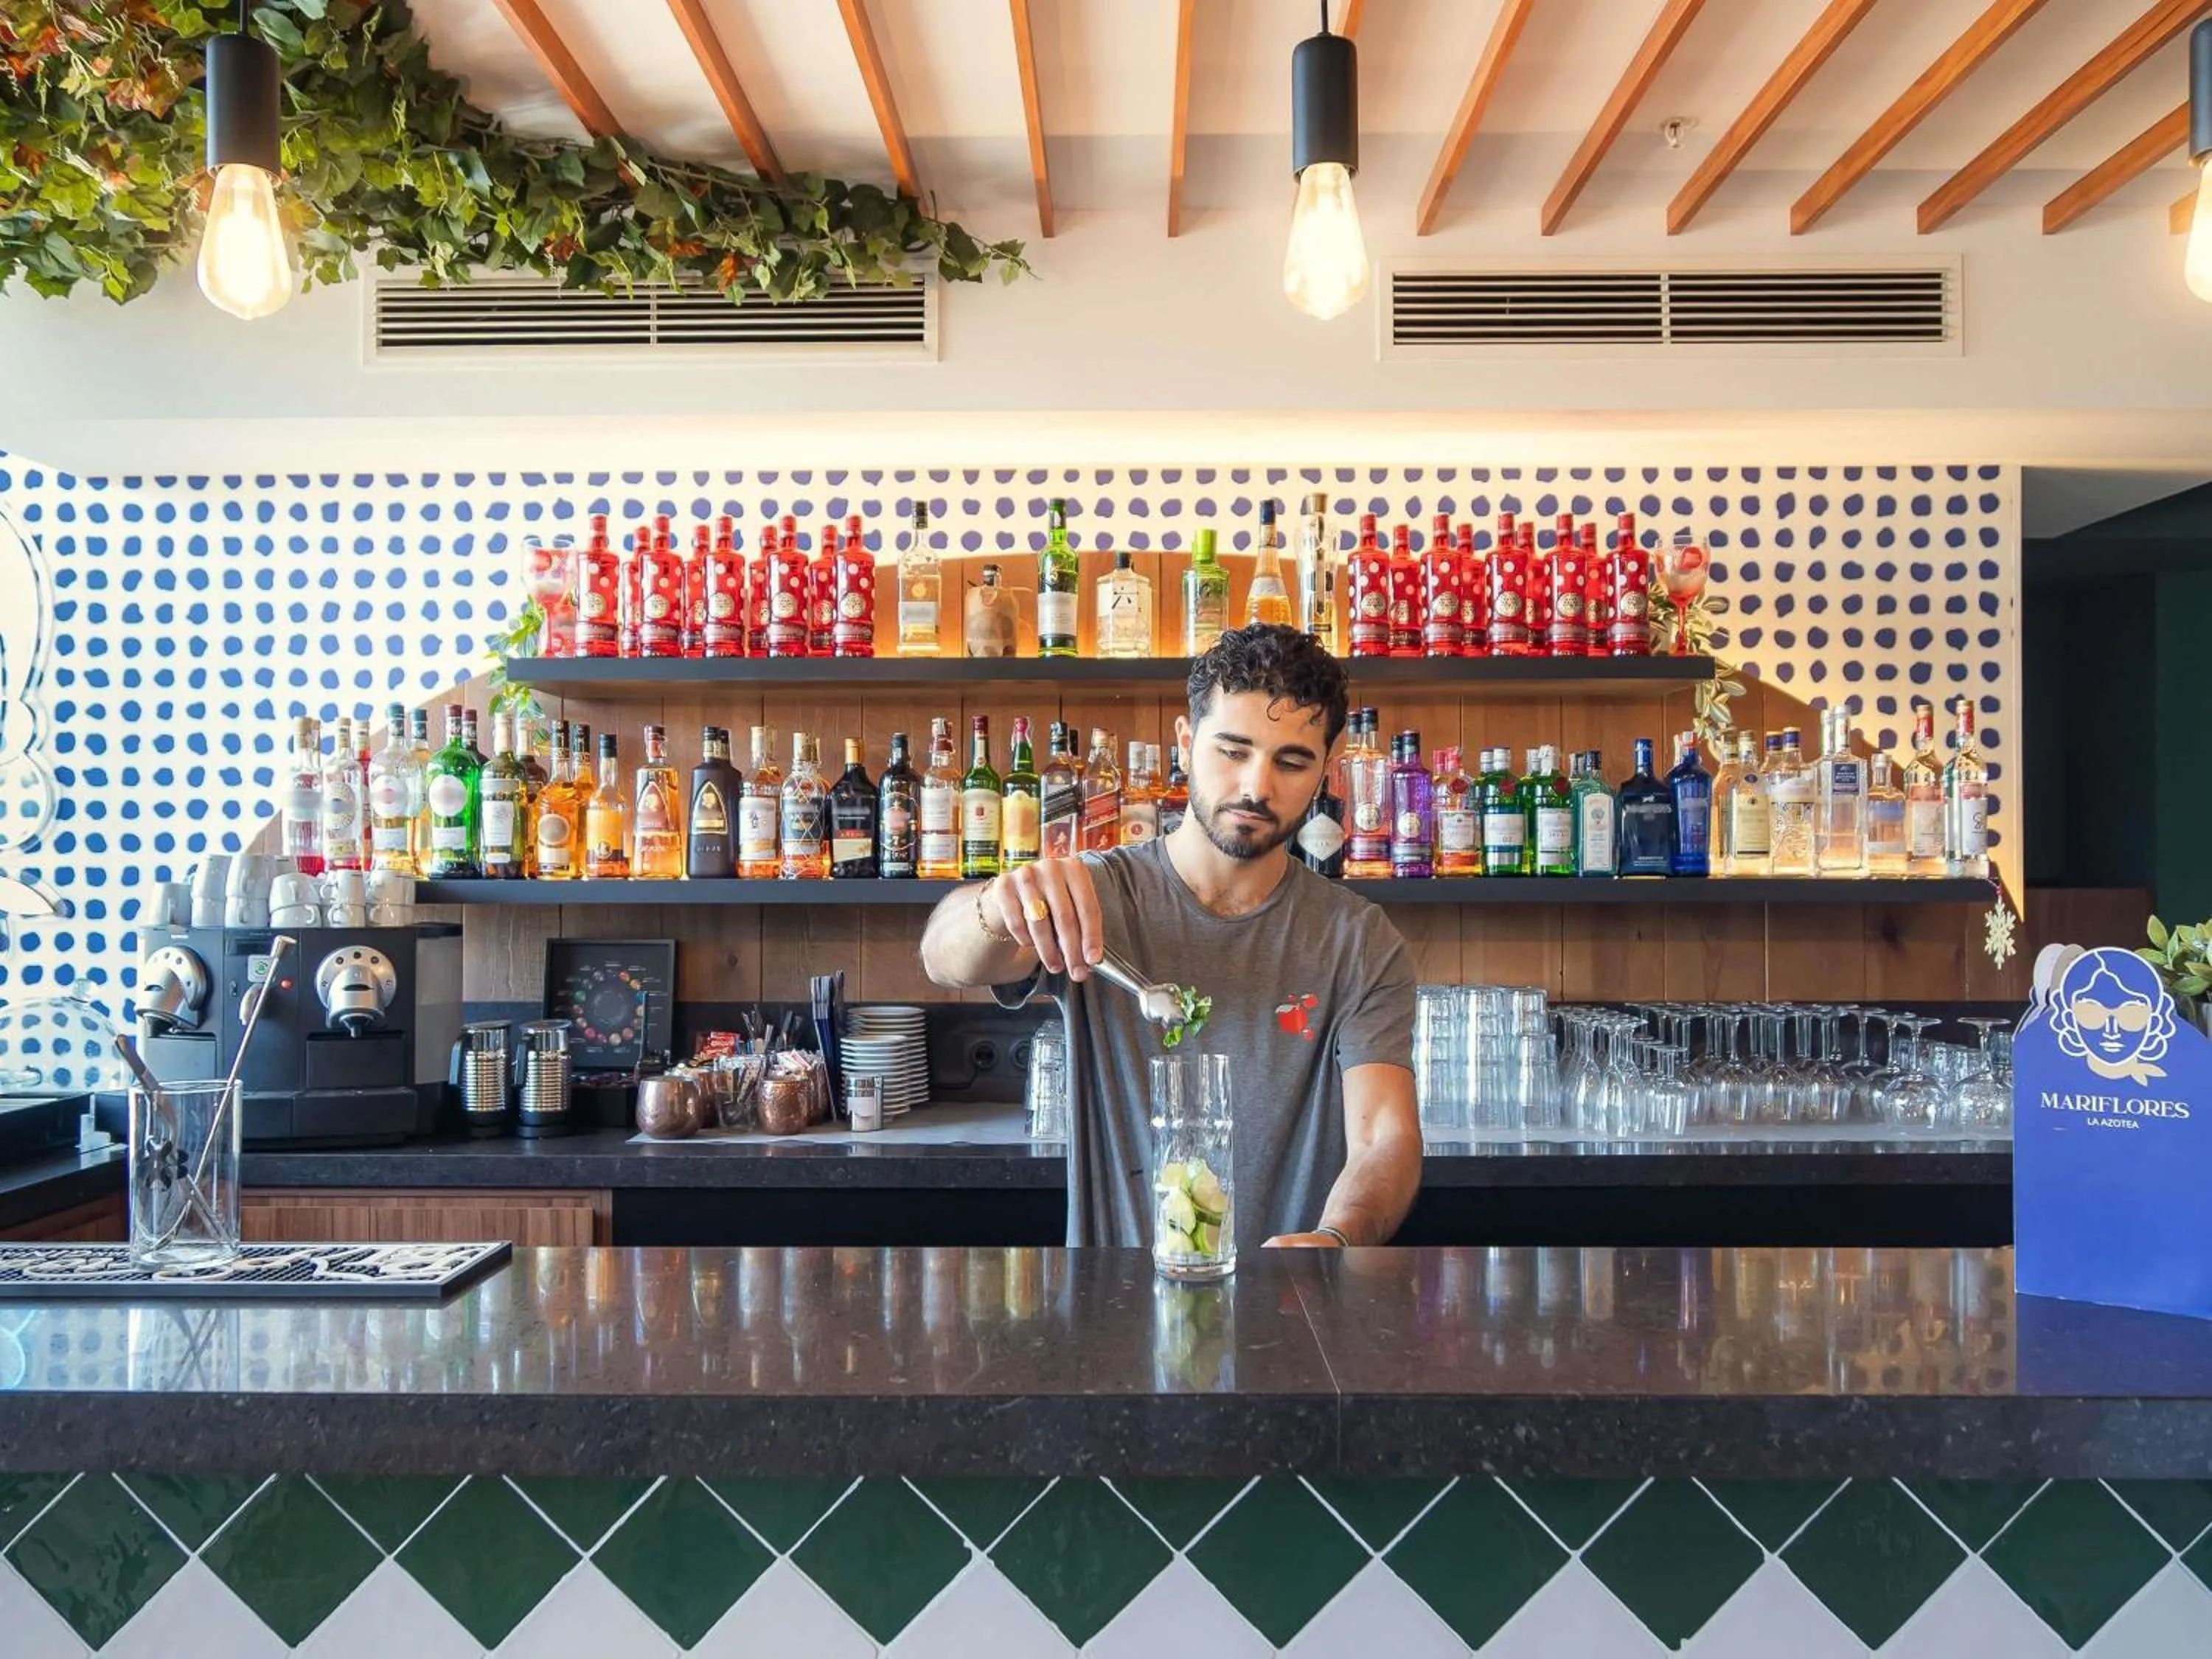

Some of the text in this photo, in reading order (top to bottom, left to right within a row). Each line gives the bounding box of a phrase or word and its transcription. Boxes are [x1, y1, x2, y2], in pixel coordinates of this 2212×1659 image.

[2040, 1092, 2190, 1119] MARIFLORES
[2087, 1117, 2139, 1128] LA AZOTEA
